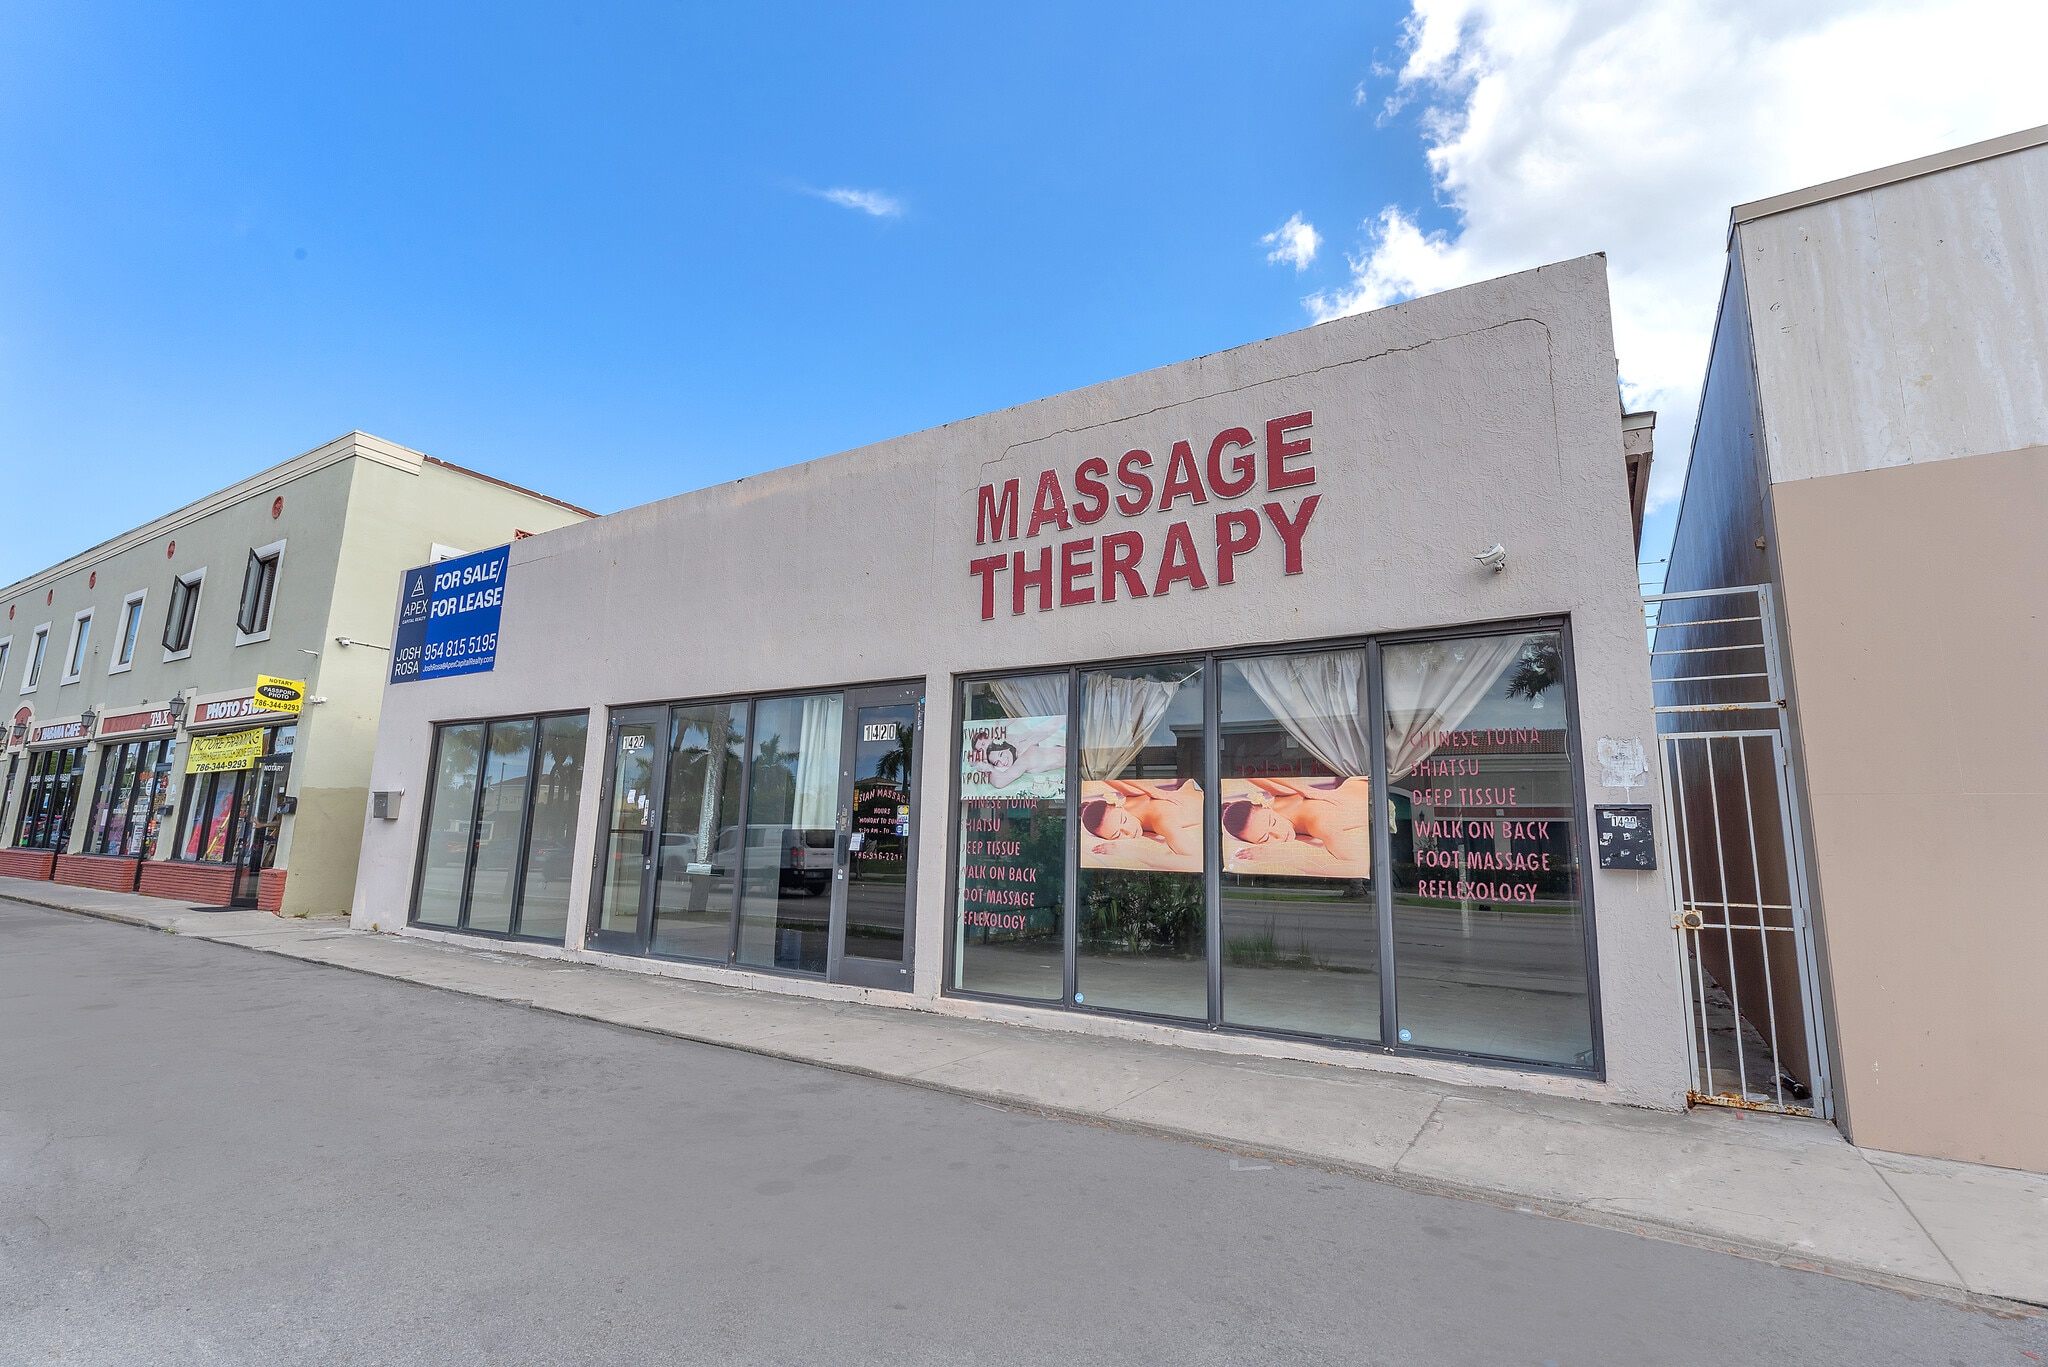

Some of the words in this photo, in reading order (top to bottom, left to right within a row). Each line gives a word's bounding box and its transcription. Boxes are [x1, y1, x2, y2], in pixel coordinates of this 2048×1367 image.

[976, 410, 1317, 545] MASSAGE
[970, 493, 1323, 621] THERAPY
[434, 570, 461, 592] FOR
[463, 556, 505, 585] SALE/
[403, 599, 429, 617] APEX
[430, 597, 457, 619] FOR
[459, 586, 503, 613] LEASE
[396, 645, 421, 662] JOSH
[424, 642, 444, 661] 954
[445, 638, 467, 658] 815
[468, 633, 497, 654] 5195
[394, 661, 419, 677] ROSA
[269, 678, 293, 686] NOTARY
[263, 686, 296, 697] PASSPORT
[268, 692, 290, 700] PHOTO
[206, 700, 240, 720] PHOTO
[254, 698, 300, 712] 786-344-9293
[150, 711, 170, 728] TAX
[65, 722, 81, 738] CAFE
[865, 724, 897, 740] 1420
[1410, 729, 1479, 748] CHINESE
[1486, 726, 1540, 746] TUINA
[624, 736, 644, 749] 1422
[195, 759, 248, 772] 786-344-9293
[264, 764, 285, 772] NOTARY
[1411, 758, 1479, 777] SHIATSU
[858, 788, 875, 803] SIAN
[1412, 788, 1453, 806] DEEP
[1459, 787, 1517, 806] TISSUE
[873, 807, 891, 815] HOURS
[1414, 820, 1463, 838] WALK
[1468, 821, 1494, 839] ON
[1502, 821, 1550, 840] BACK
[987, 841, 1021, 856] TISSUE
[1417, 850, 1460, 869] FOOT
[1467, 852, 1550, 871] MASSAGE
[989, 866, 1005, 881] ON
[1009, 867, 1037, 883] BACK
[964, 888, 983, 903] OOT
[986, 889, 1035, 907] MASSAGE
[1418, 880, 1538, 903] REFLEXOLOGY
[963, 911, 1026, 930] EFLEXOLOGY
